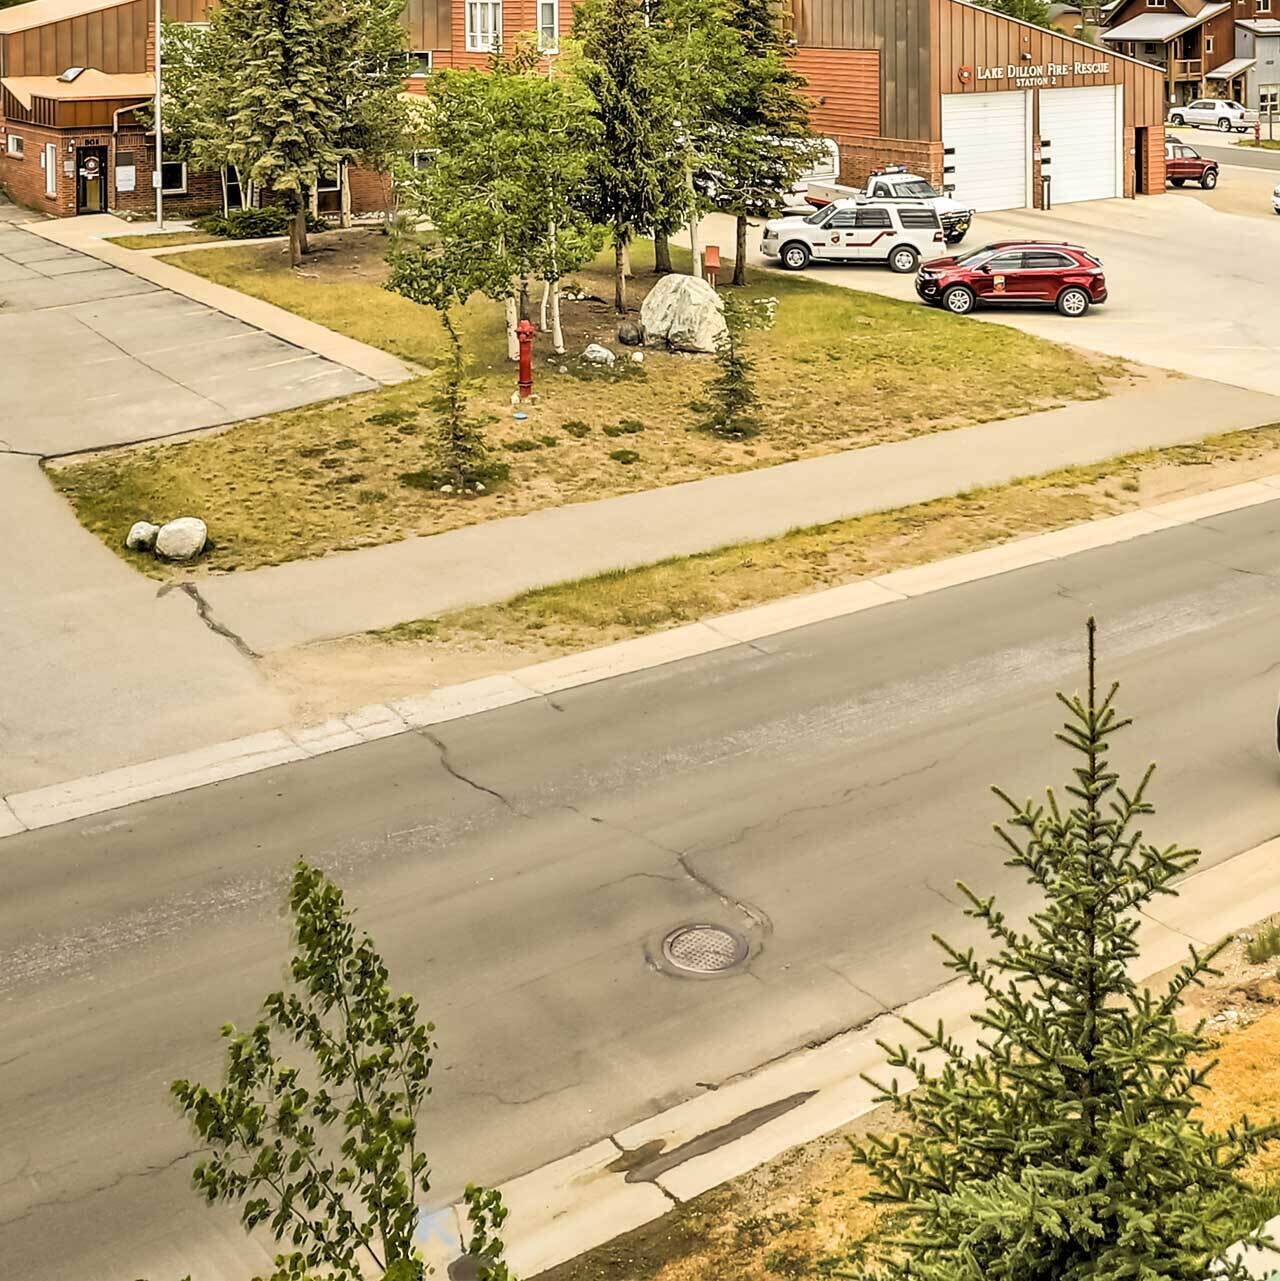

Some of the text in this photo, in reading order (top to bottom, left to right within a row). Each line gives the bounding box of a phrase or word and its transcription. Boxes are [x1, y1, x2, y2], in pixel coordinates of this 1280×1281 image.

[977, 66, 1004, 80] LAKE
[1007, 64, 1043, 78] DILLON
[1016, 77, 1057, 87] STATION 2
